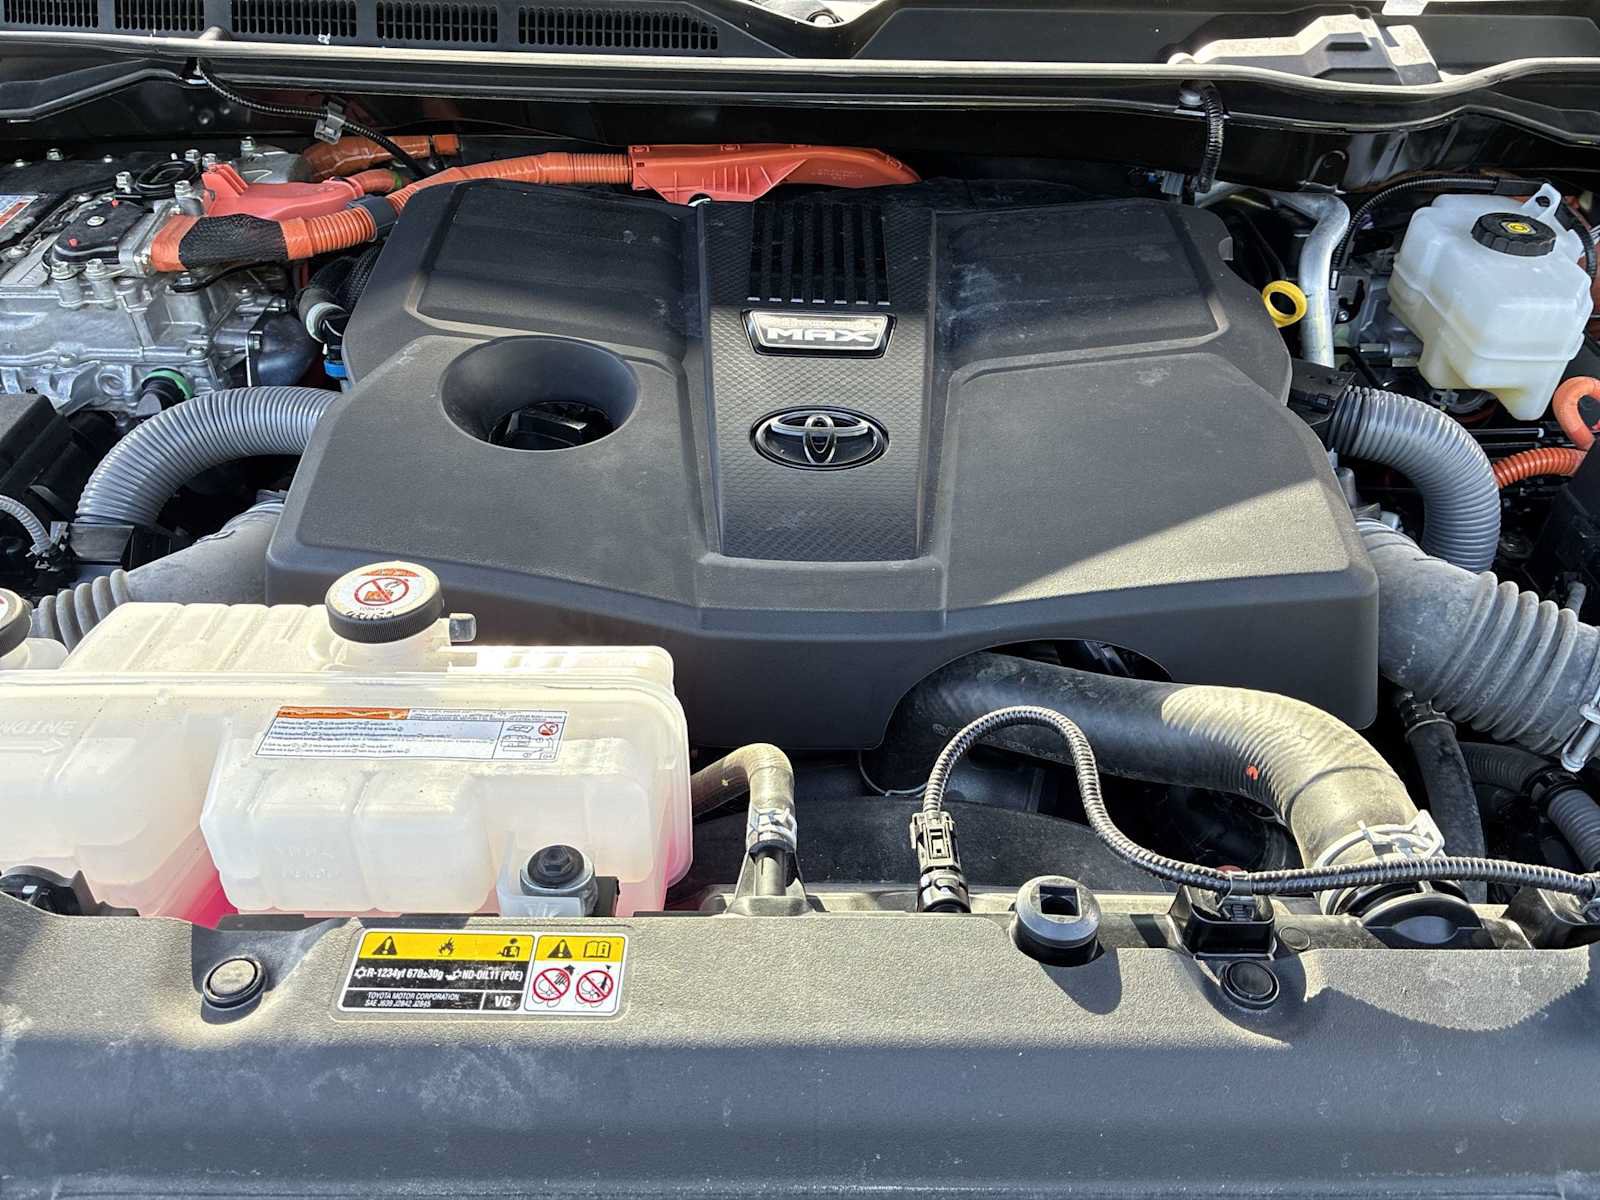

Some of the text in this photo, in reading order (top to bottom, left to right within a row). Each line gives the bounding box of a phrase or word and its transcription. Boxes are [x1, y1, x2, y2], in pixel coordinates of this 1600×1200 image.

[767, 327, 877, 343] MAX
[0, 719, 77, 737] NGINE
[500, 970, 524, 982] (POE)
[367, 991, 460, 1001] TOYOTA MOTOR CORPORATION
[364, 999, 378, 1007] SAE
